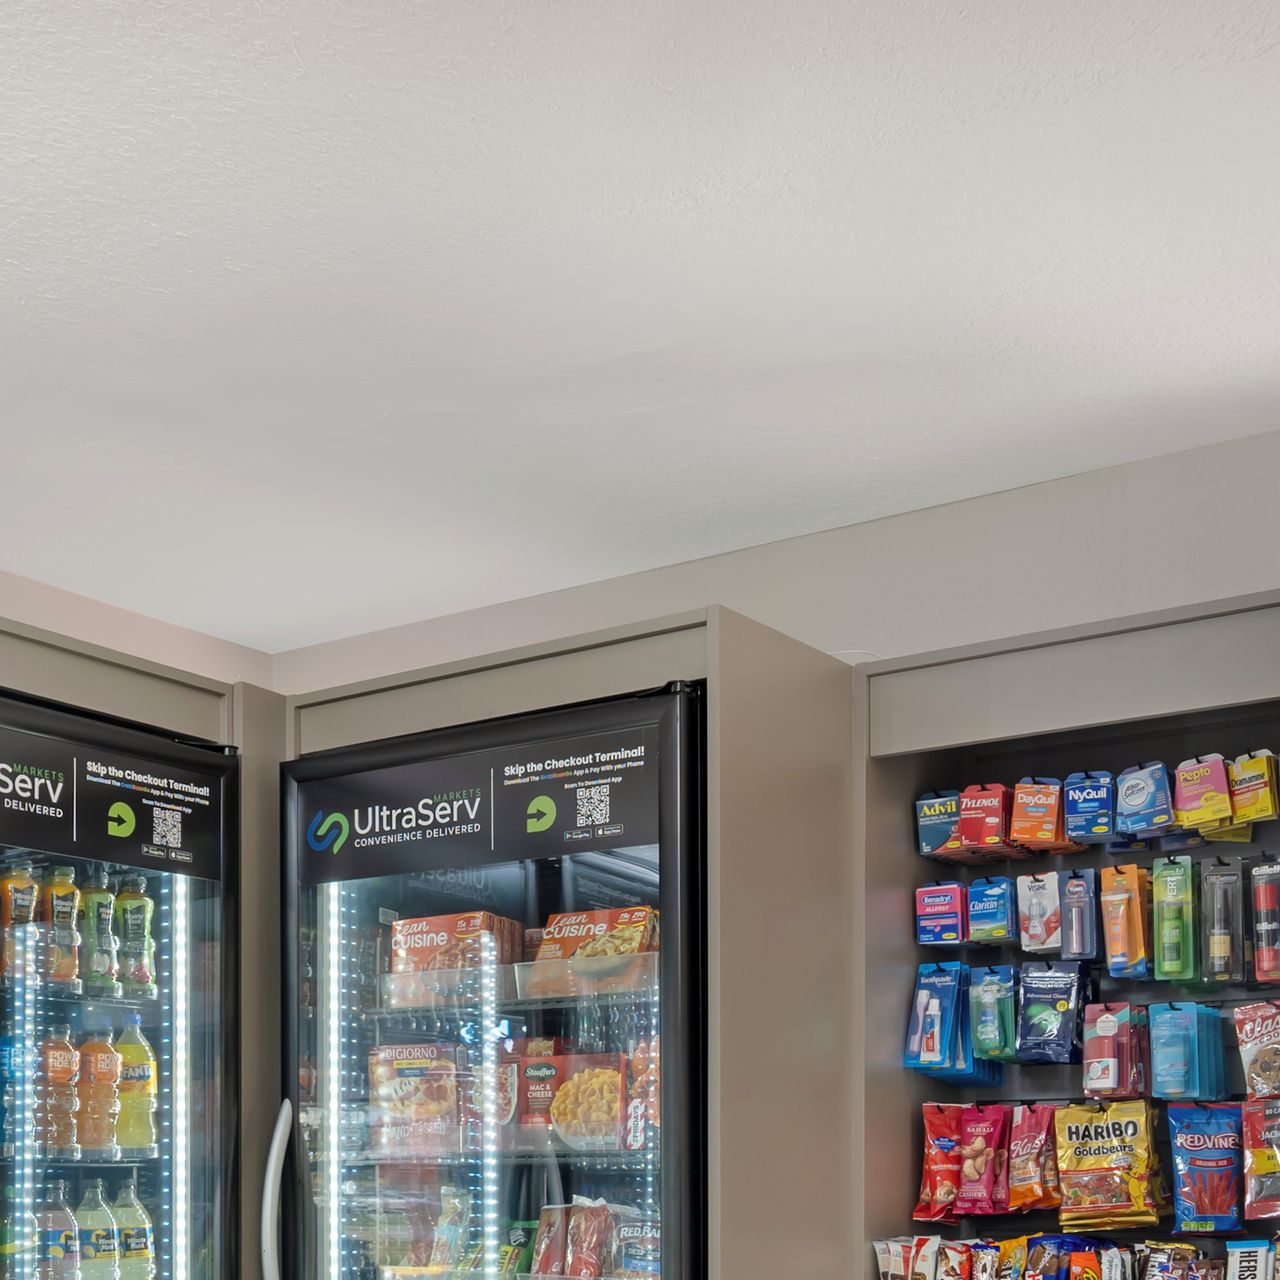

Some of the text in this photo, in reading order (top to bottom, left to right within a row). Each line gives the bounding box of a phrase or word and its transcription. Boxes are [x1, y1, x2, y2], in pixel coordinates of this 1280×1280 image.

[504, 766, 525, 777] Skip
[526, 762, 542, 773] the
[545, 754, 593, 770] Checkout
[595, 746, 645, 762] Terminal!
[12, 763, 64, 782] MARKETS
[87, 761, 107, 776] Skip
[108, 766, 123, 778] the
[125, 770, 168, 788] Checkout
[169, 780, 210, 796] Terminal!
[1179, 767, 1211, 782] Pepto
[1231, 772, 1266, 788] Dramamine
[434, 788, 481, 802] MARKETS
[961, 797, 1000, 808] TYLENOL
[1018, 793, 1056, 806] DayQuil
[1069, 788, 1107, 803] NyQuil
[4, 798, 63, 818] DELIVERED
[354, 798, 481, 834] UltraServ
[920, 801, 957, 817] Advil
[354, 823, 481, 848] CONVENIENCE DELIVERED
[970, 900, 998, 912] Claritin
[551, 914, 588, 930] Lean
[527, 1090, 552, 1098] CHEESE
[1067, 1120, 1139, 1142] HARIBO
[1073, 1144, 1135, 1157] Goldbears
